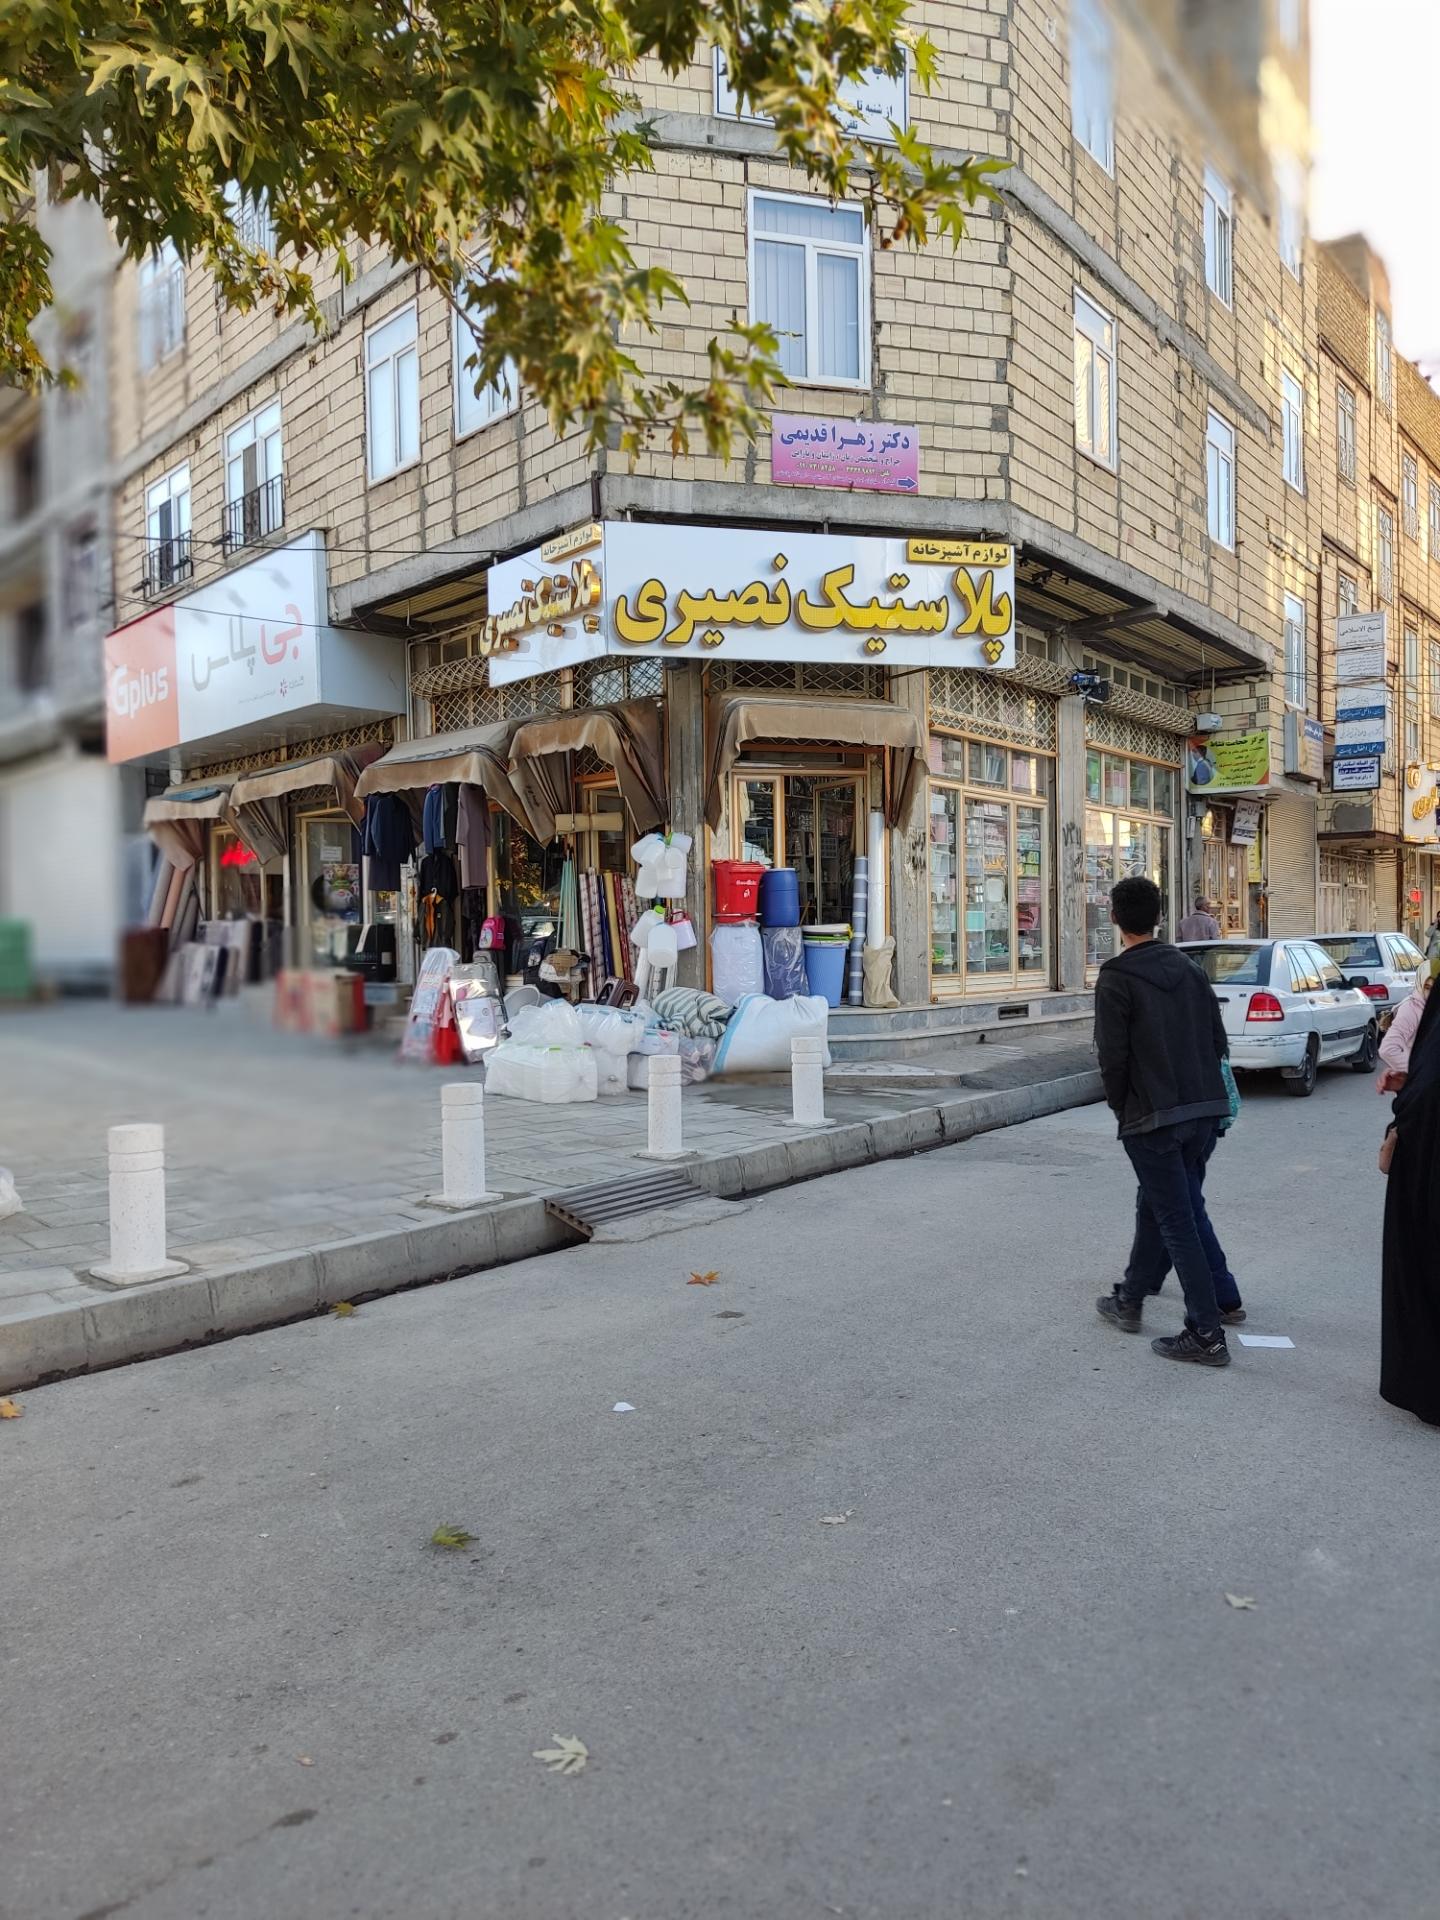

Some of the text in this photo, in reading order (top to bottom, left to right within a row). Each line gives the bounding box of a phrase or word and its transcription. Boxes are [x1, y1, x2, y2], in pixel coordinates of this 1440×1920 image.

[780, 423, 910, 454] دکتر زهرا قدیمی
[912, 543, 1008, 563] لوازم آشپزخانه
[614, 552, 1014, 664] پلاستیک نصیری
[191, 603, 304, 692] جی پلاس
[1225, 739, 1249, 747] حجامت
[1250, 736, 1265, 746] مرکز
